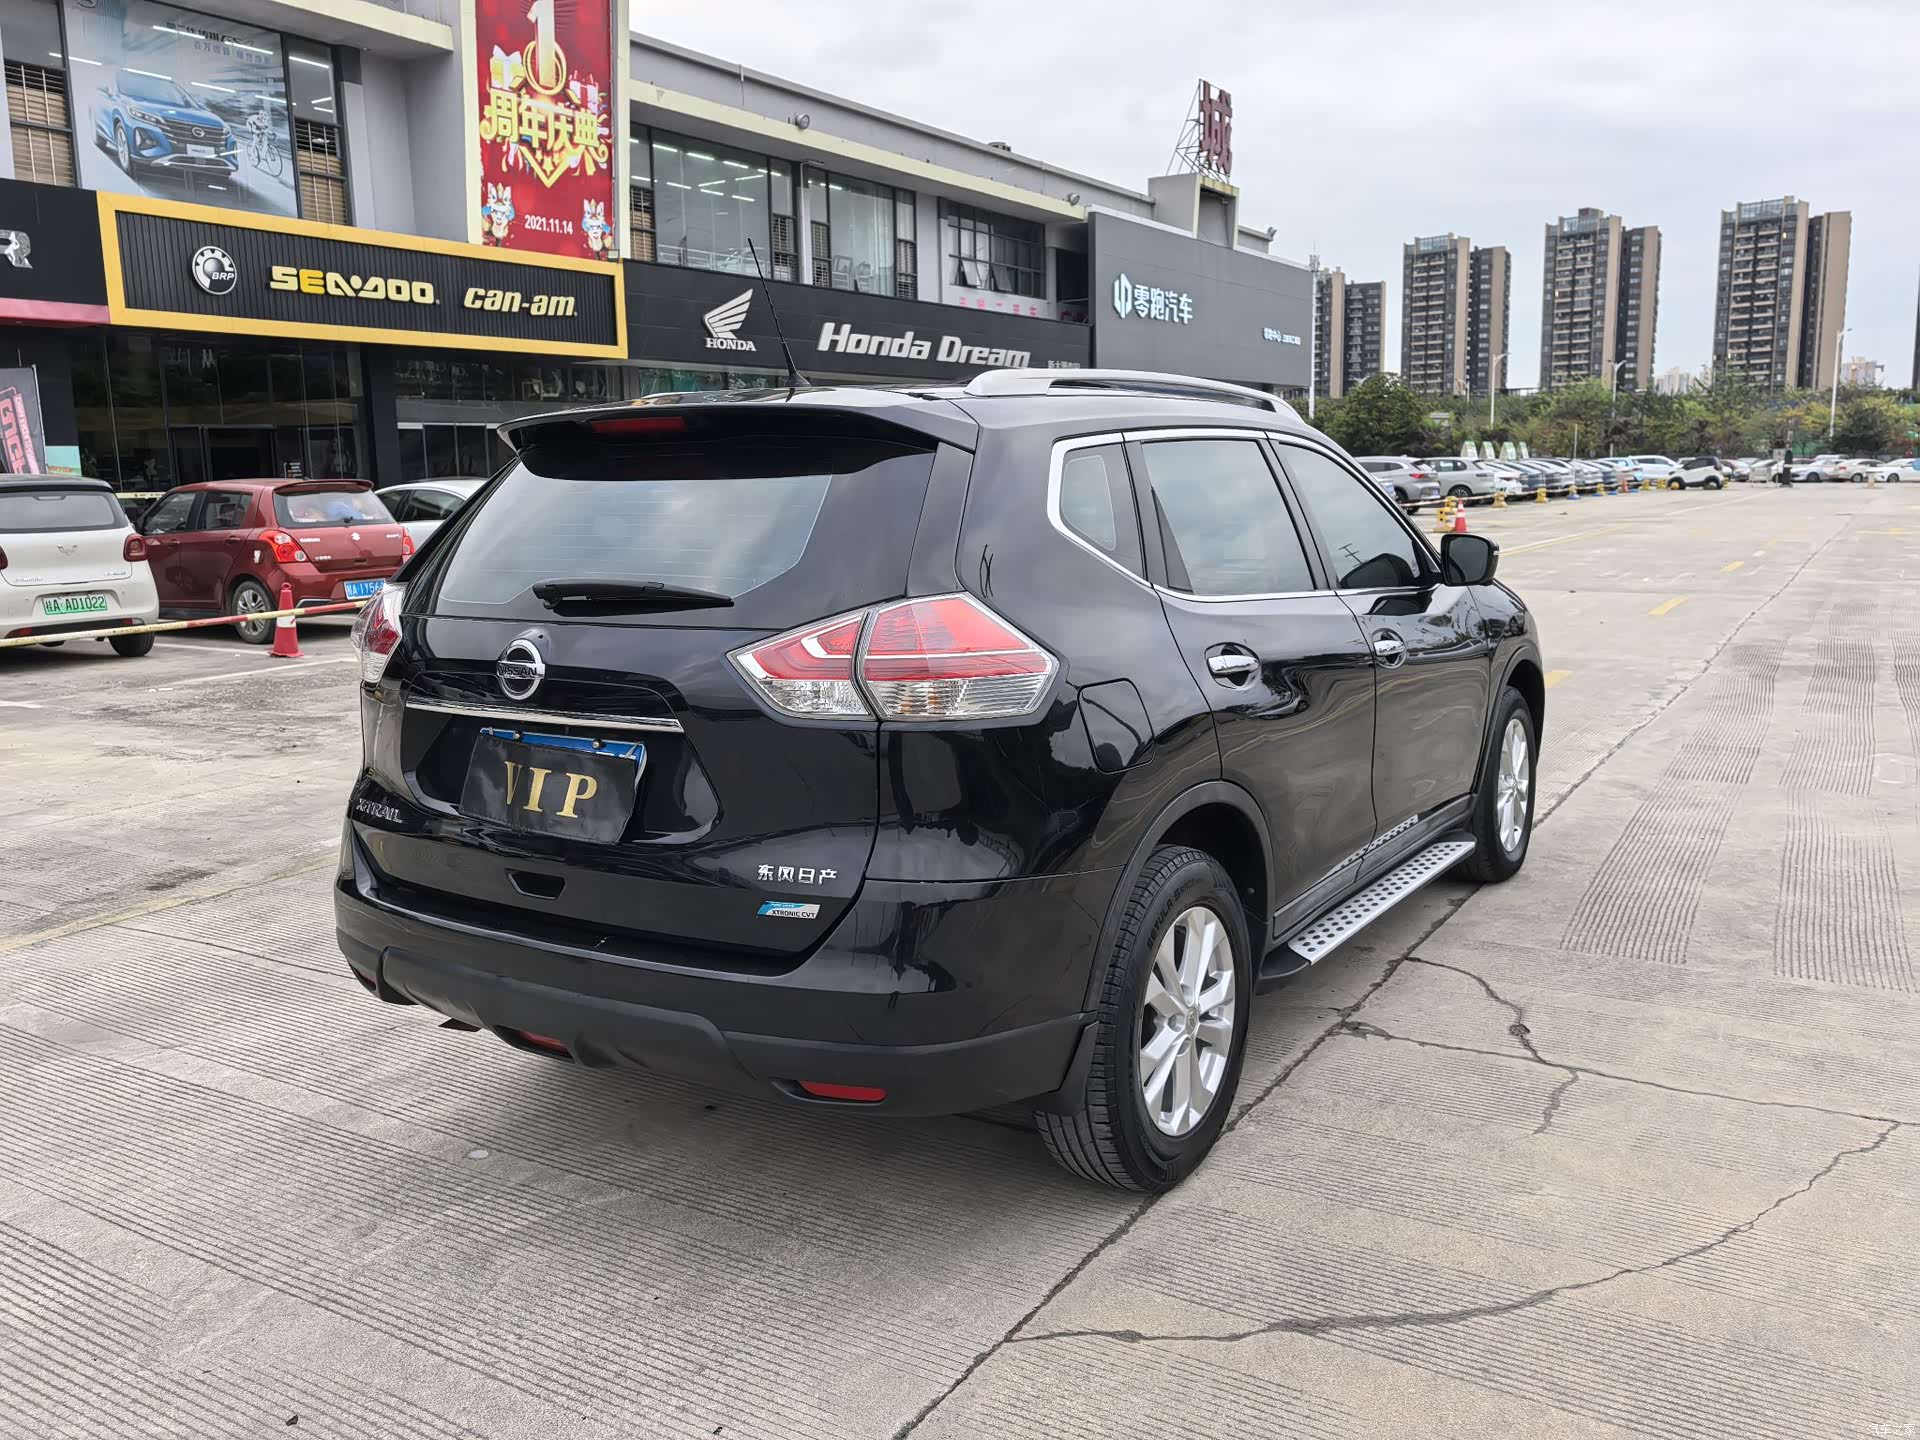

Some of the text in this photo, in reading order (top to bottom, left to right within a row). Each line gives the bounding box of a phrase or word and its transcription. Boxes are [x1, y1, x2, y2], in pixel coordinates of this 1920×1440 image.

[484, 87, 604, 151] 周年庆典
[524, 214, 574, 235] 2021.11.14
[211, 271, 235, 281] BRP
[463, 287, 577, 317] can-am
[1133, 284, 1193, 324] 零跑汽车
[705, 337, 757, 352] HONDA
[816, 321, 1031, 369] Honda Dream
[65, 596, 106, 611] AD1022
[497, 663, 538, 677] NISSAN
[504, 760, 598, 818] VIP
[757, 863, 838, 886] 东风日产
[771, 909, 801, 918] XTRONIC
